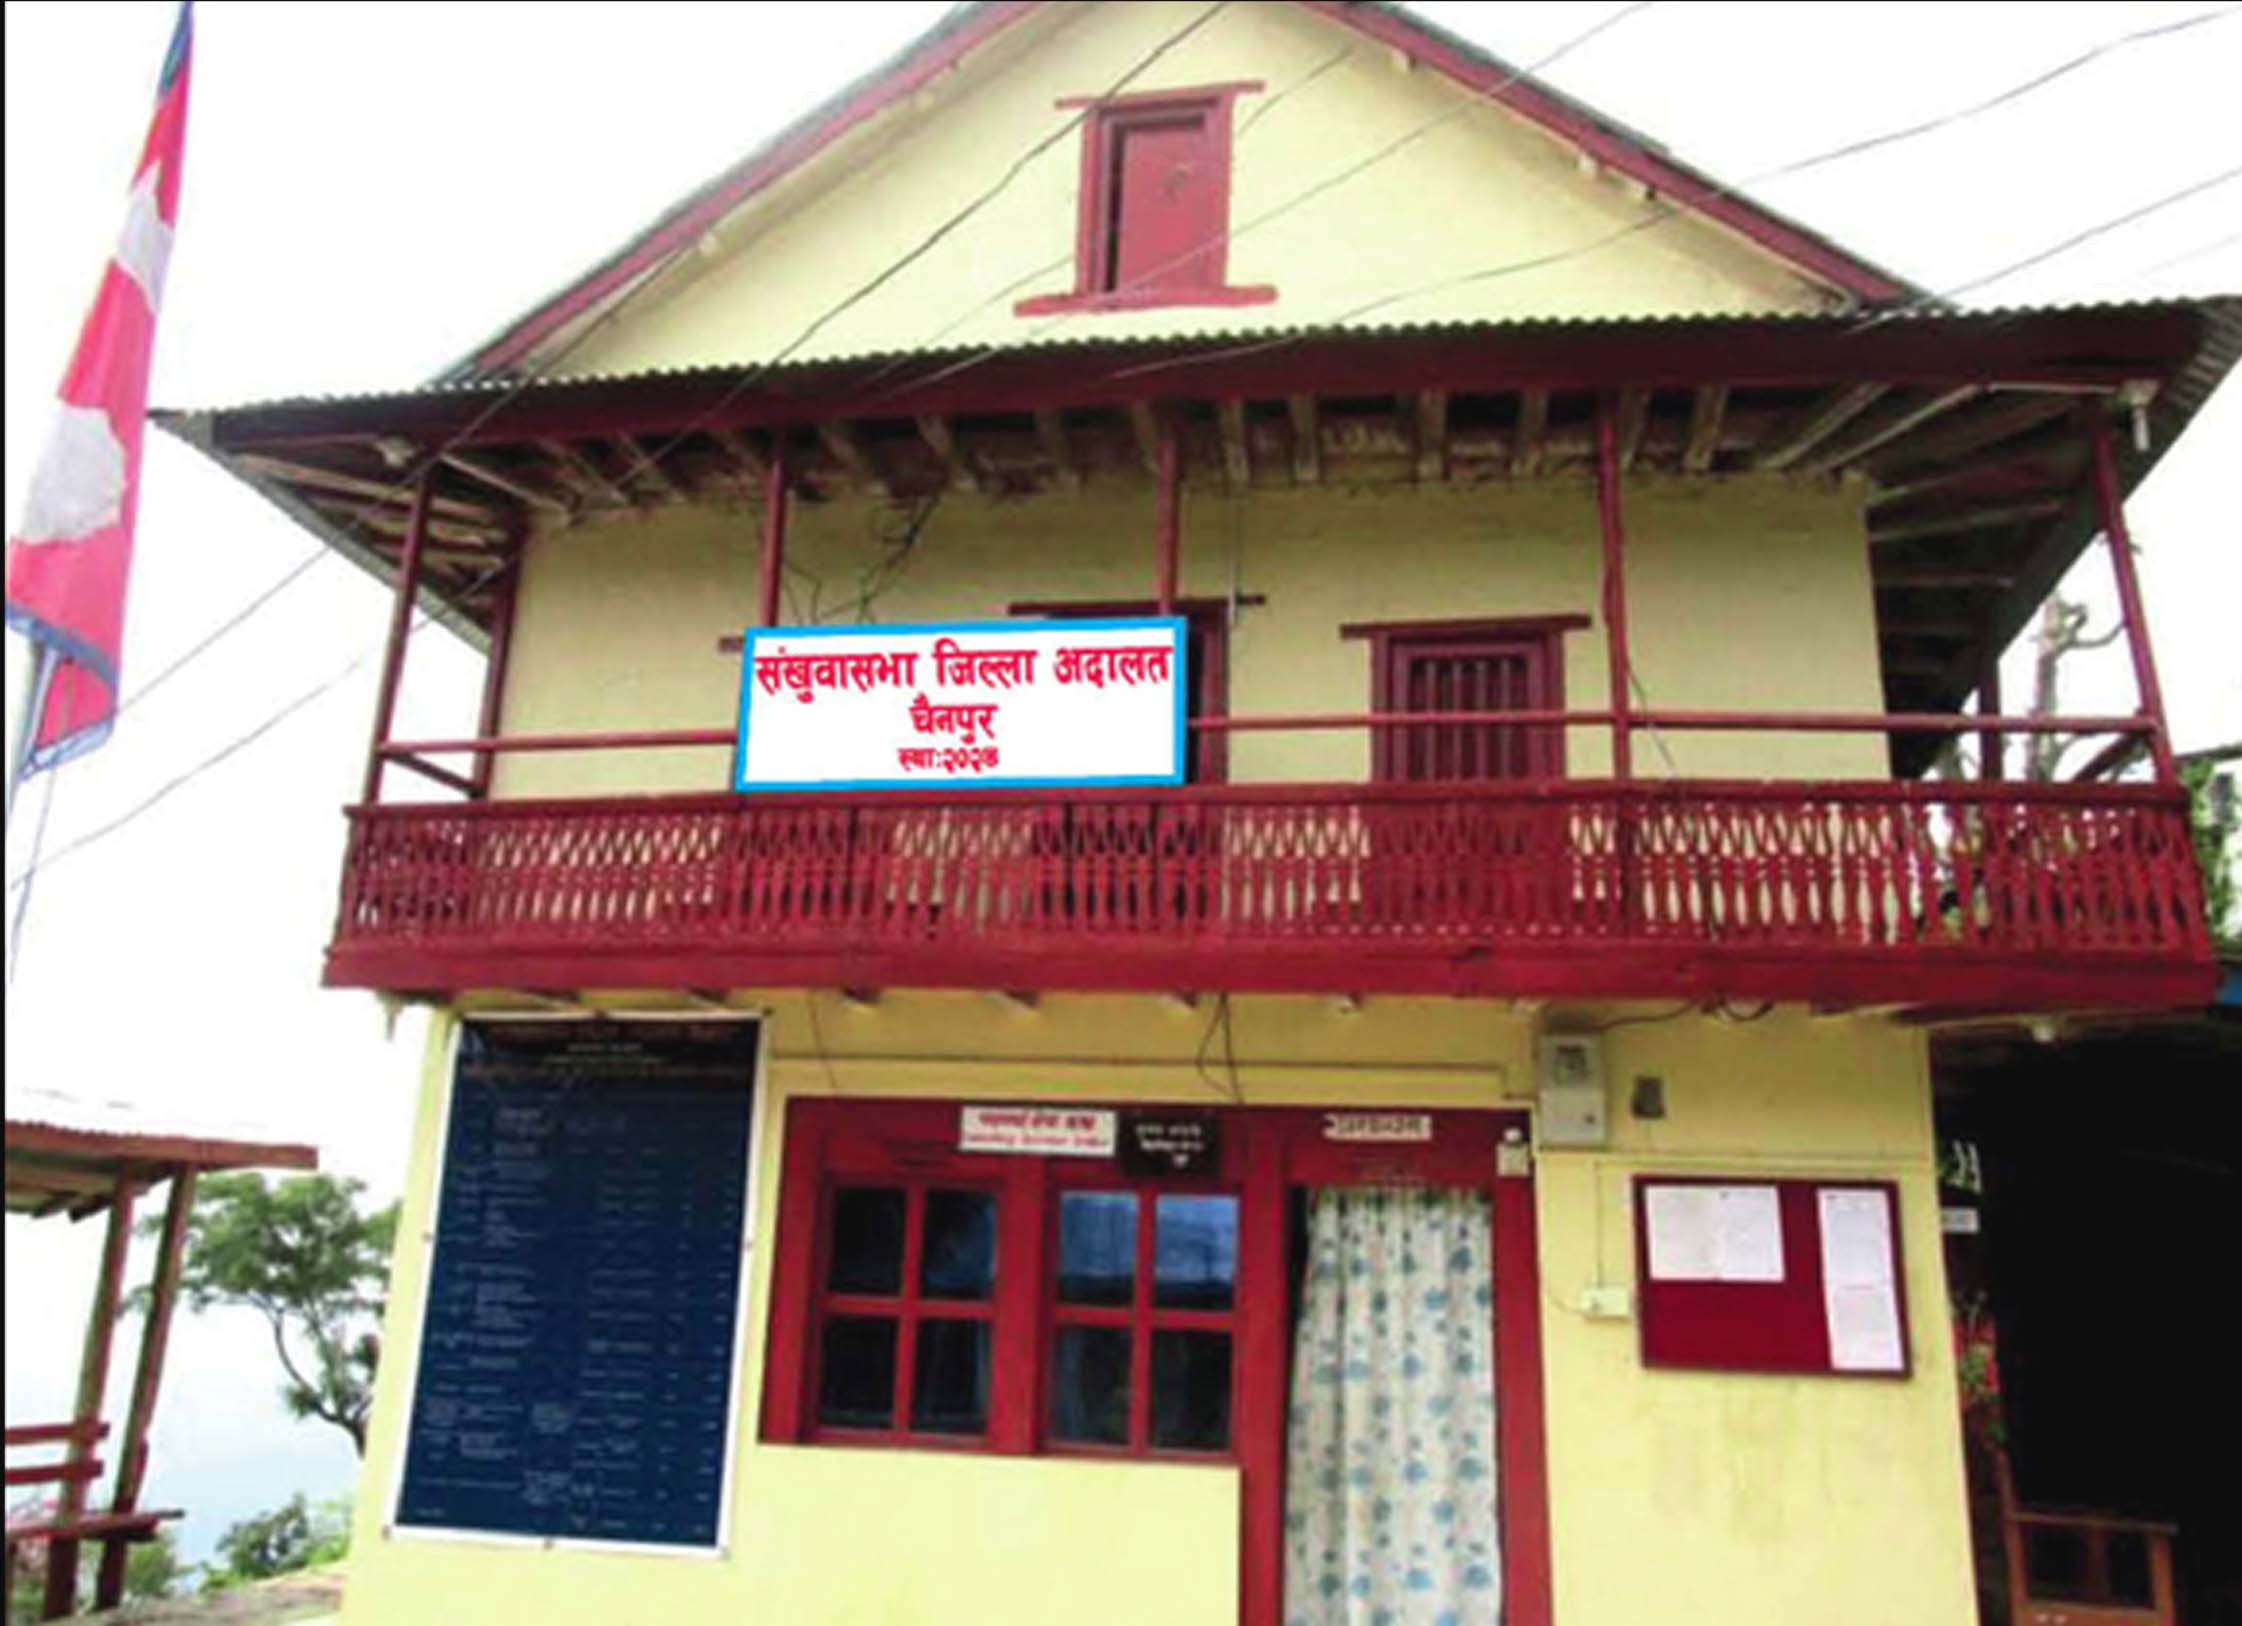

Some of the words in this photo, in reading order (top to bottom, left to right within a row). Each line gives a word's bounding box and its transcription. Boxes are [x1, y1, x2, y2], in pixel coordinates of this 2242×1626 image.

[755, 646, 918, 703] संखुवासभा
[932, 637, 1038, 688] जिल्ला
[1053, 645, 1174, 689] अदालत
[908, 692, 999, 745] चैनपुर
